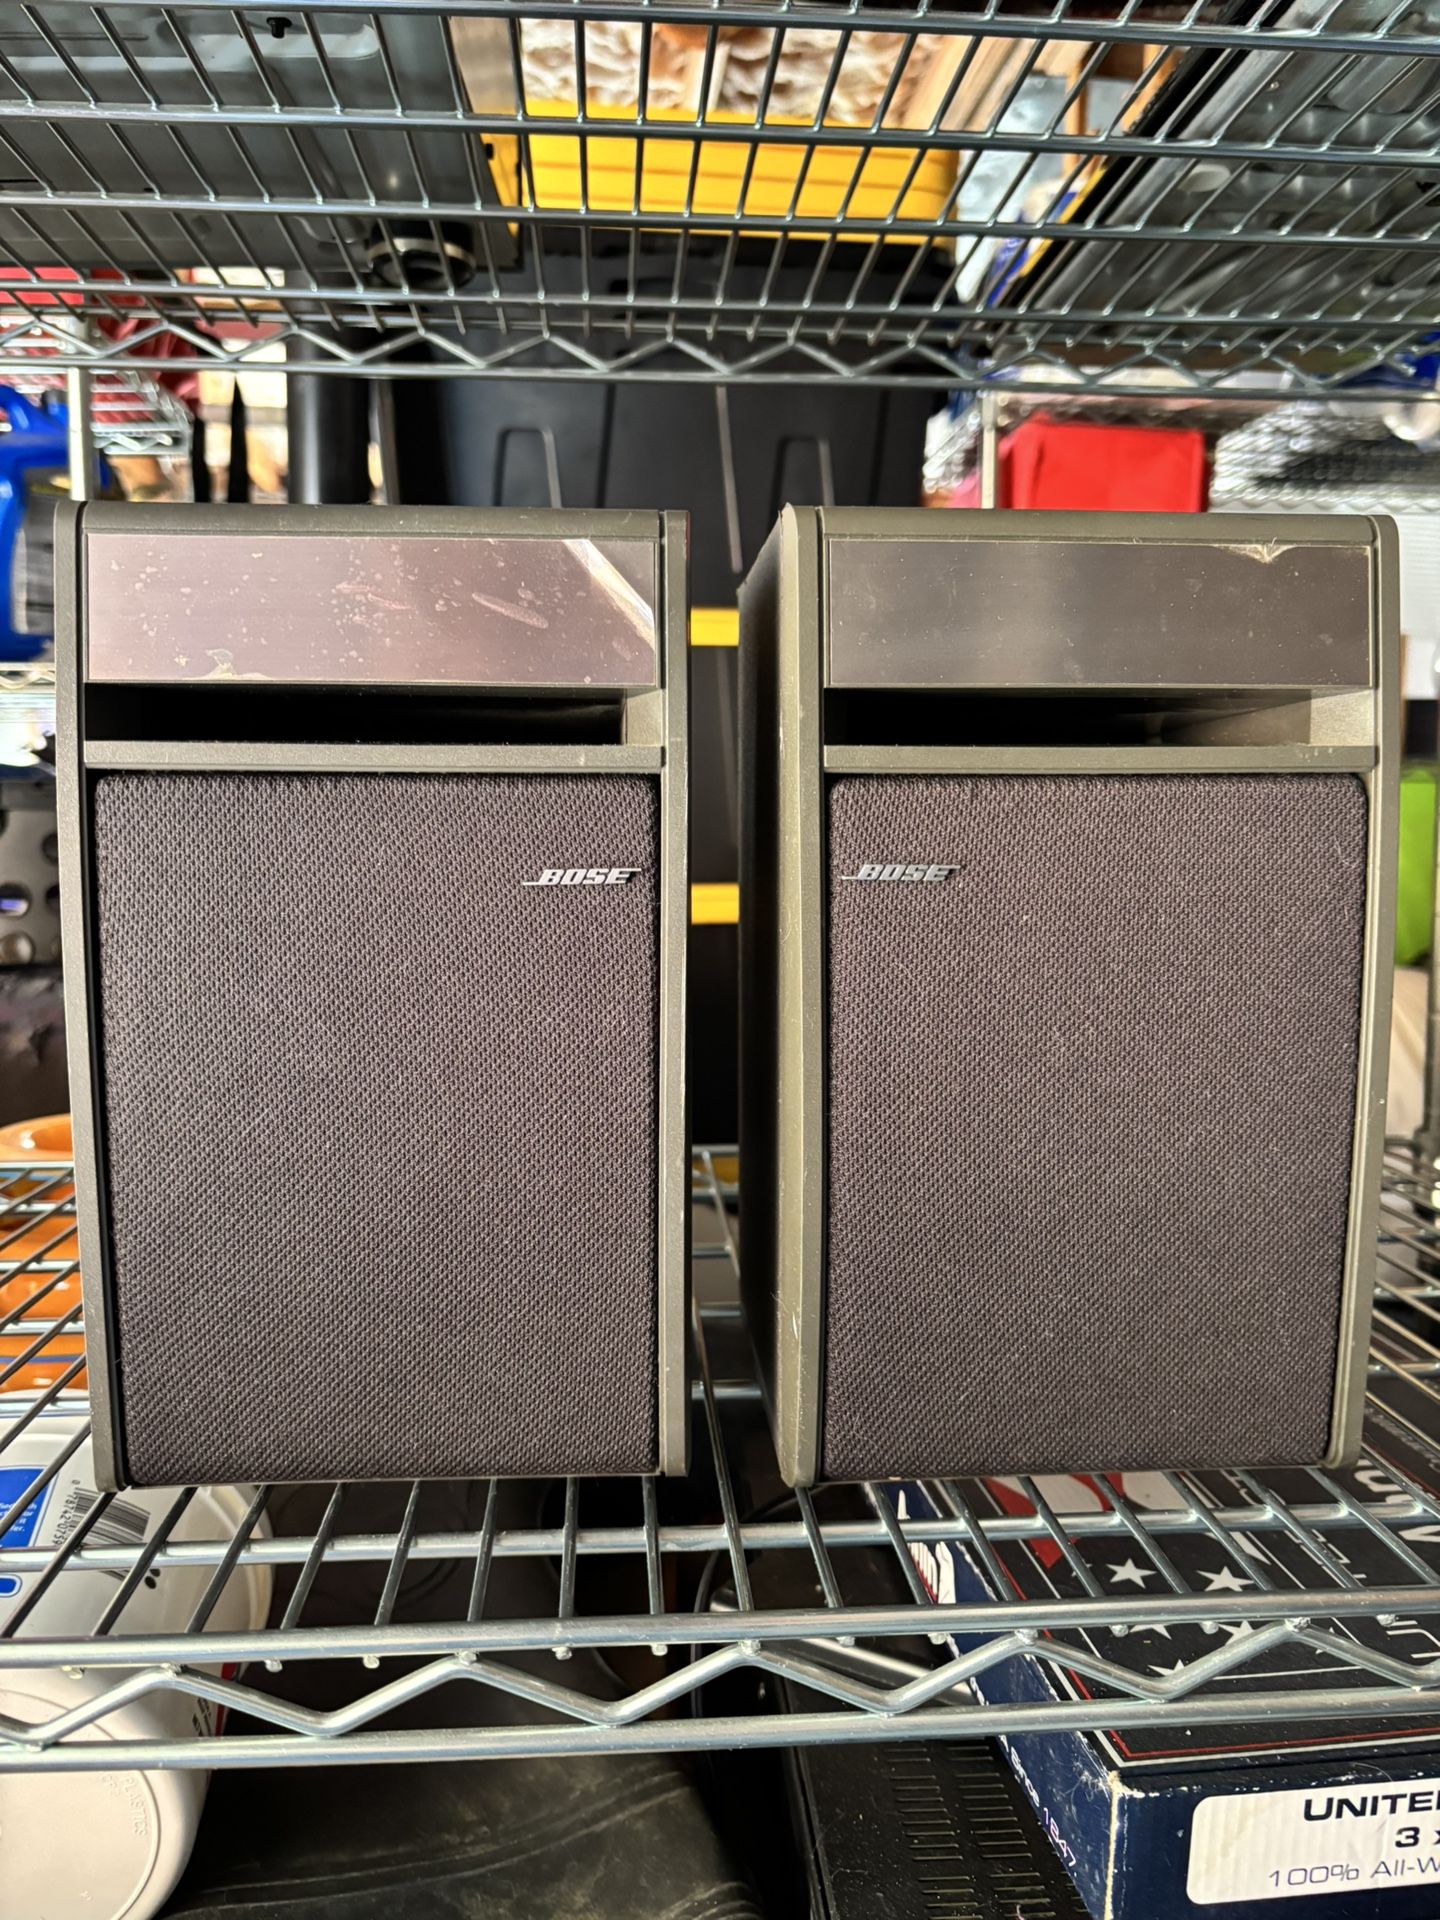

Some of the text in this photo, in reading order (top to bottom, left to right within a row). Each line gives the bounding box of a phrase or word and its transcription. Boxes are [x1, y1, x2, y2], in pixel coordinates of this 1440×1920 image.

[522, 867, 642, 886] BOSE
[841, 864, 961, 881] BOSE
[1303, 1790, 1440, 1822] UNITE
[1043, 1807, 1077, 1867] 1847
[1394, 1826, 1421, 1849] 3
[1269, 1863, 1360, 1888] 100%
